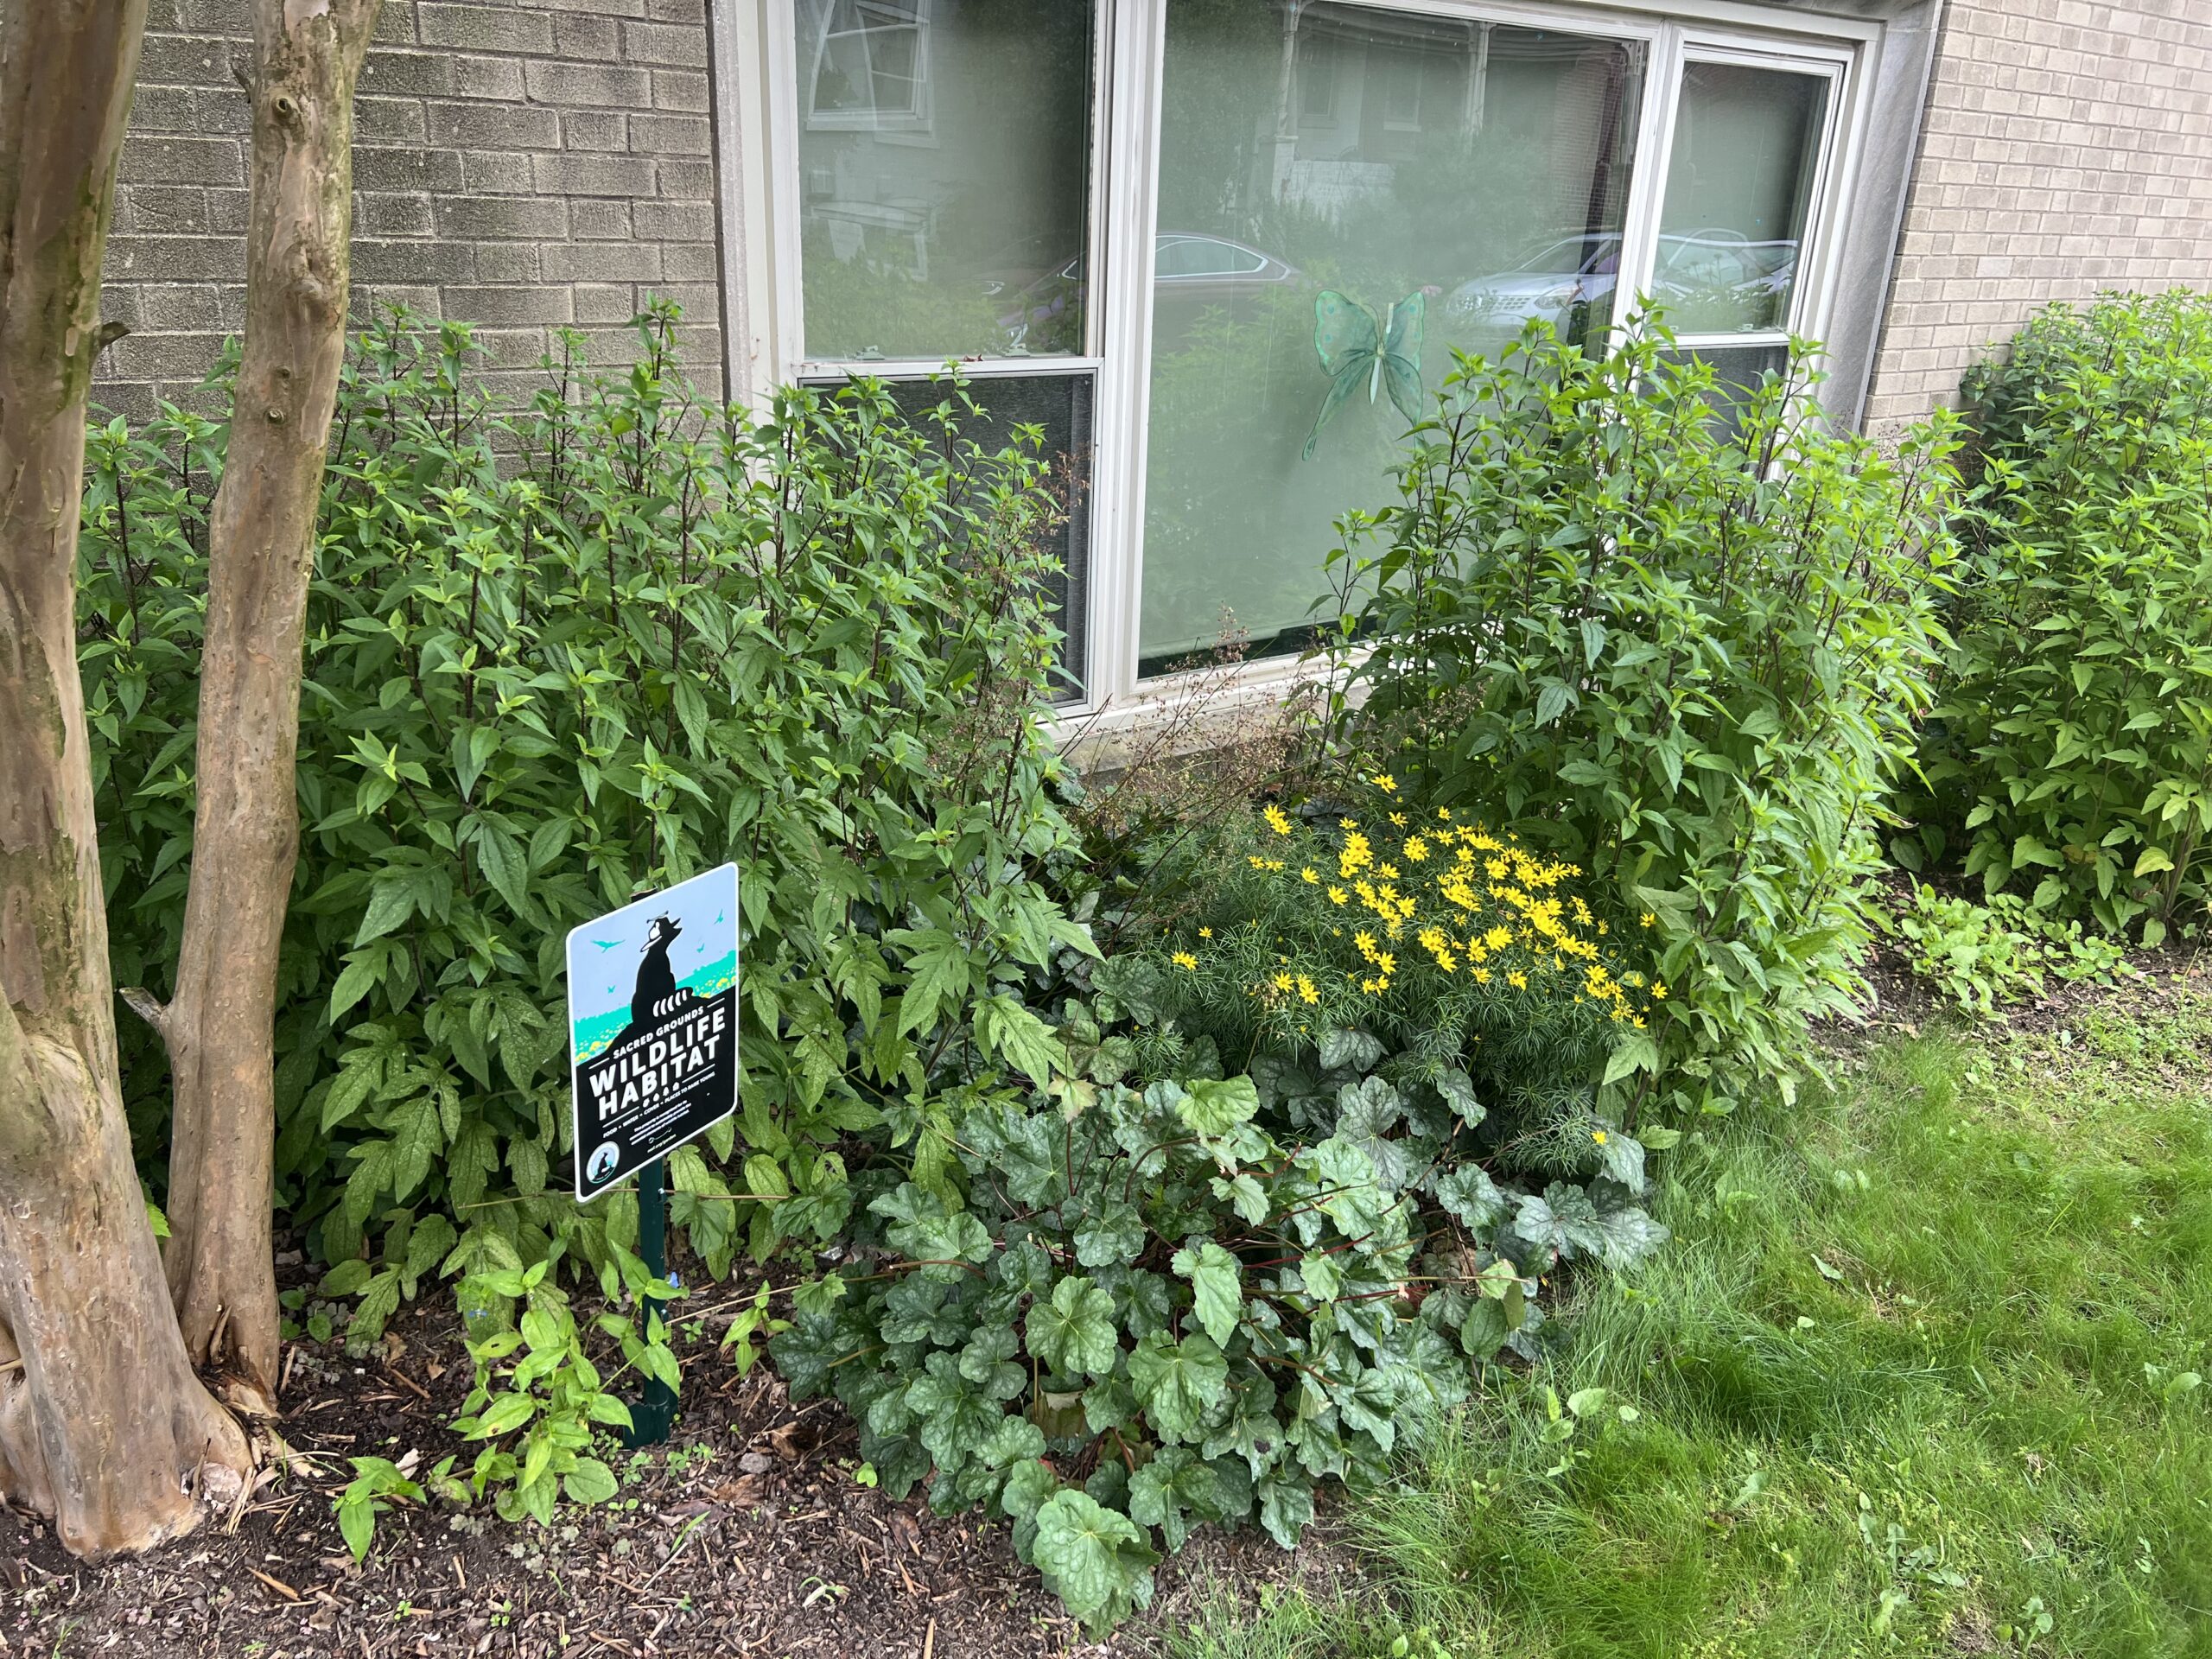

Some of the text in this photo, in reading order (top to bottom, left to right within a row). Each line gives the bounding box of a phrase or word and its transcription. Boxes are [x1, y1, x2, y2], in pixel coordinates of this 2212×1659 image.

[588, 1007, 726, 1097] WILDLIFE
[613, 1006, 704, 1059] SACRED GROUNDS
[599, 1034, 720, 1121] HABITAT
[602, 1127, 618, 1138] FOOD
[643, 1103, 660, 1115] COVER
[664, 1091, 681, 1103] PLACES
